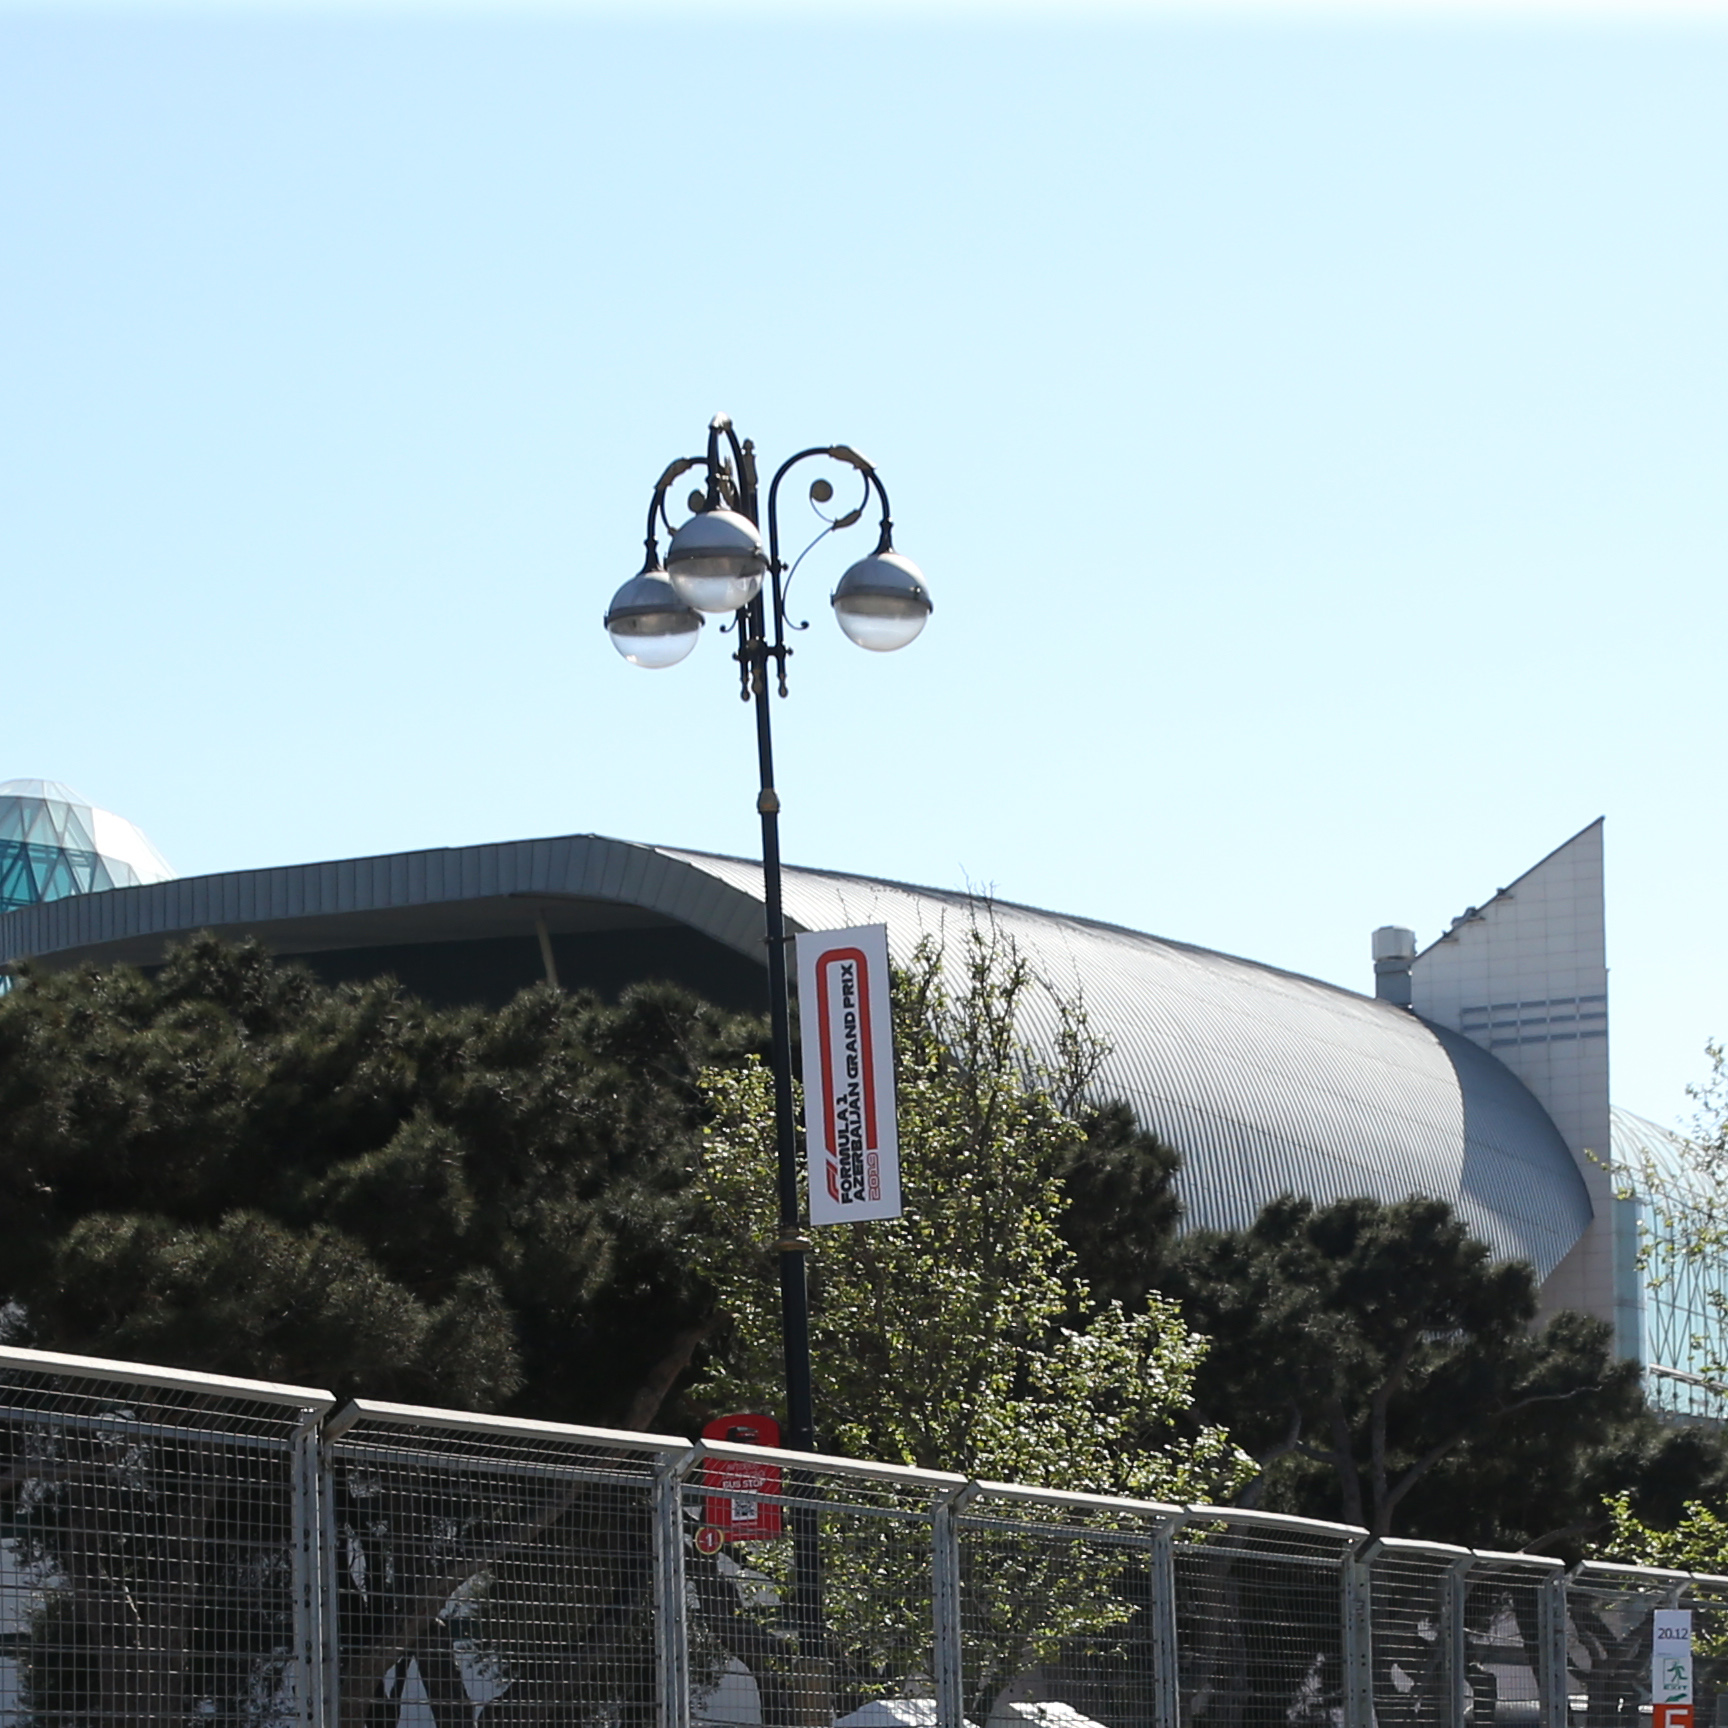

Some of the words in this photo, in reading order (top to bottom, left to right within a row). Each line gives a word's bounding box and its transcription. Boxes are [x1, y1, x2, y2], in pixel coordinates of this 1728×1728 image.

[840, 963, 856, 1009] PRIX
[844, 1011, 860, 1080] GRAND
[836, 1093, 849, 1106] 1
[837, 1108, 854, 1204] FORMULA
[849, 1082, 866, 1202] AZERBAIJAN
[867, 1152, 882, 1202] 2019
[1657, 1627, 1689, 1640] 20.12
